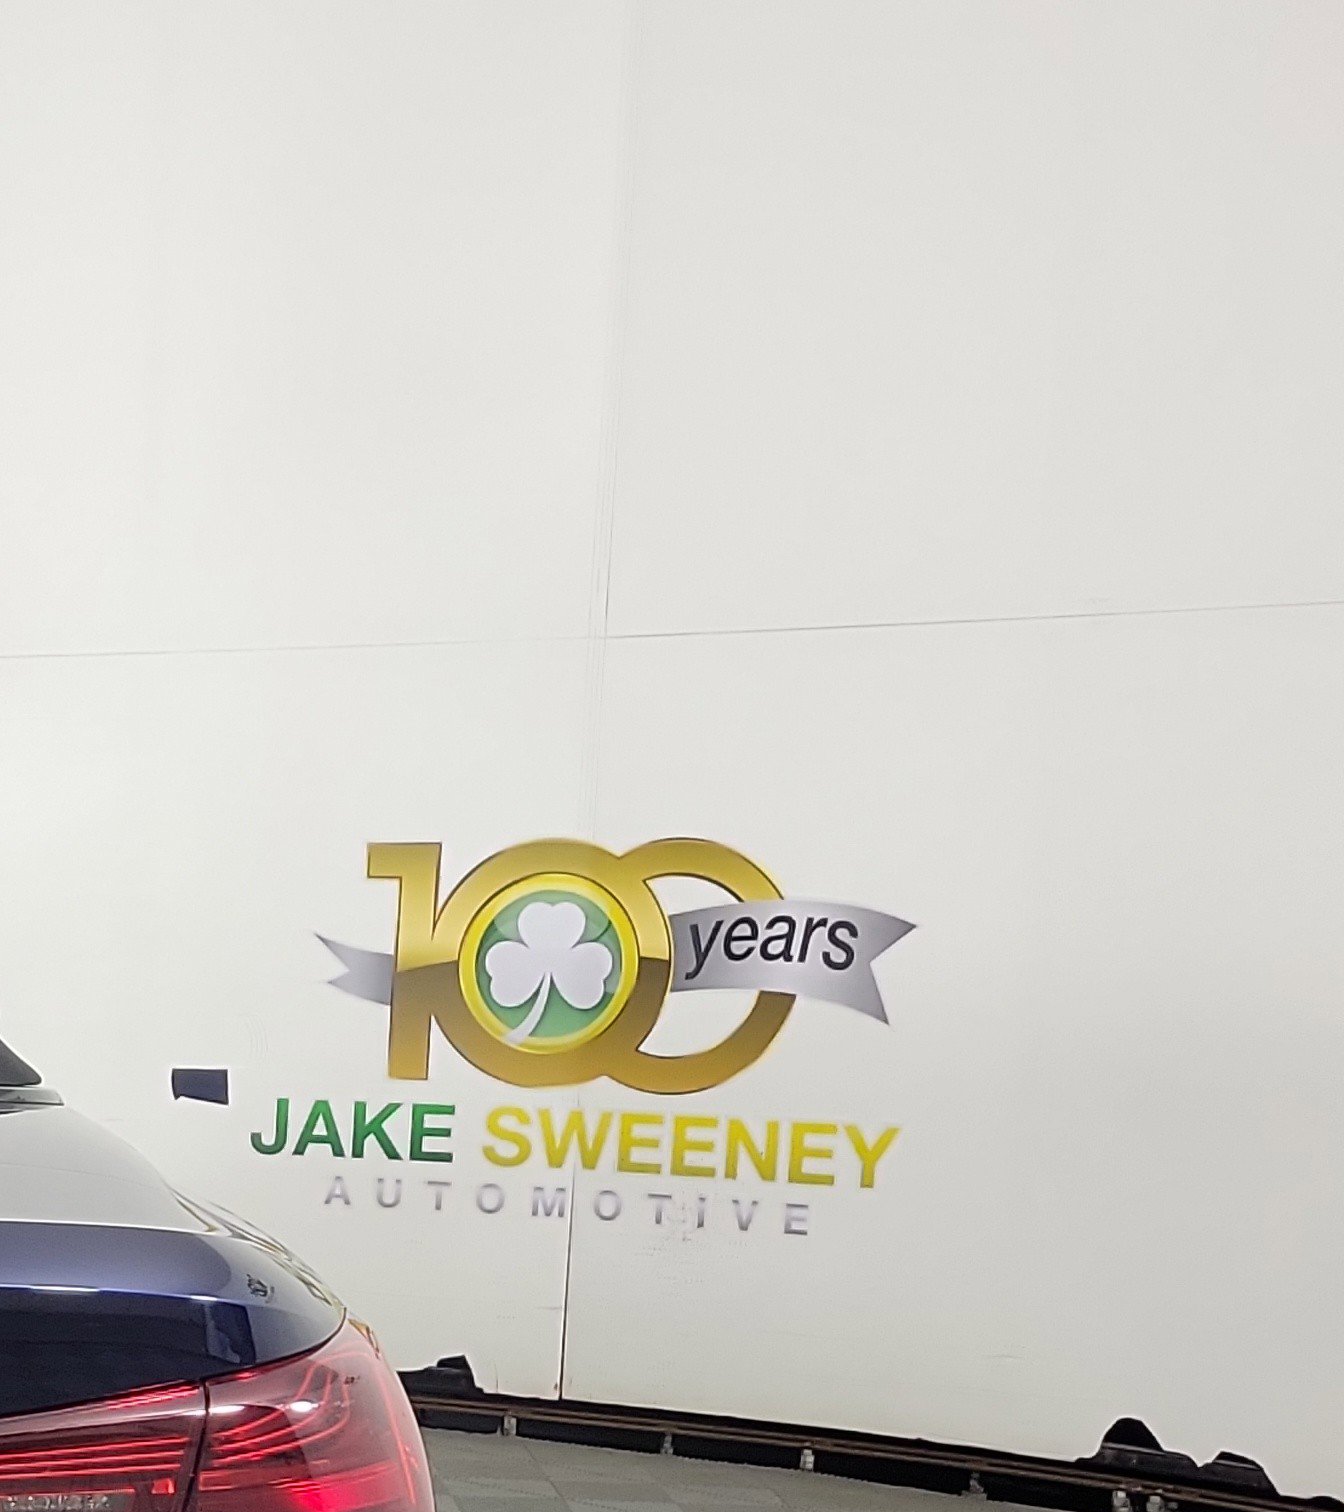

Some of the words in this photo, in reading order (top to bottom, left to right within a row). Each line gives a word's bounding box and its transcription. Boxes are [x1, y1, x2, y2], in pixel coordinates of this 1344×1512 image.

[367, 836, 796, 1095] 100
[685, 914, 859, 982] years
[250, 1097, 455, 1164] JAKE
[481, 1106, 900, 1189] SWEENEY
[324, 1176, 810, 1236] AUTOMOTIVE
